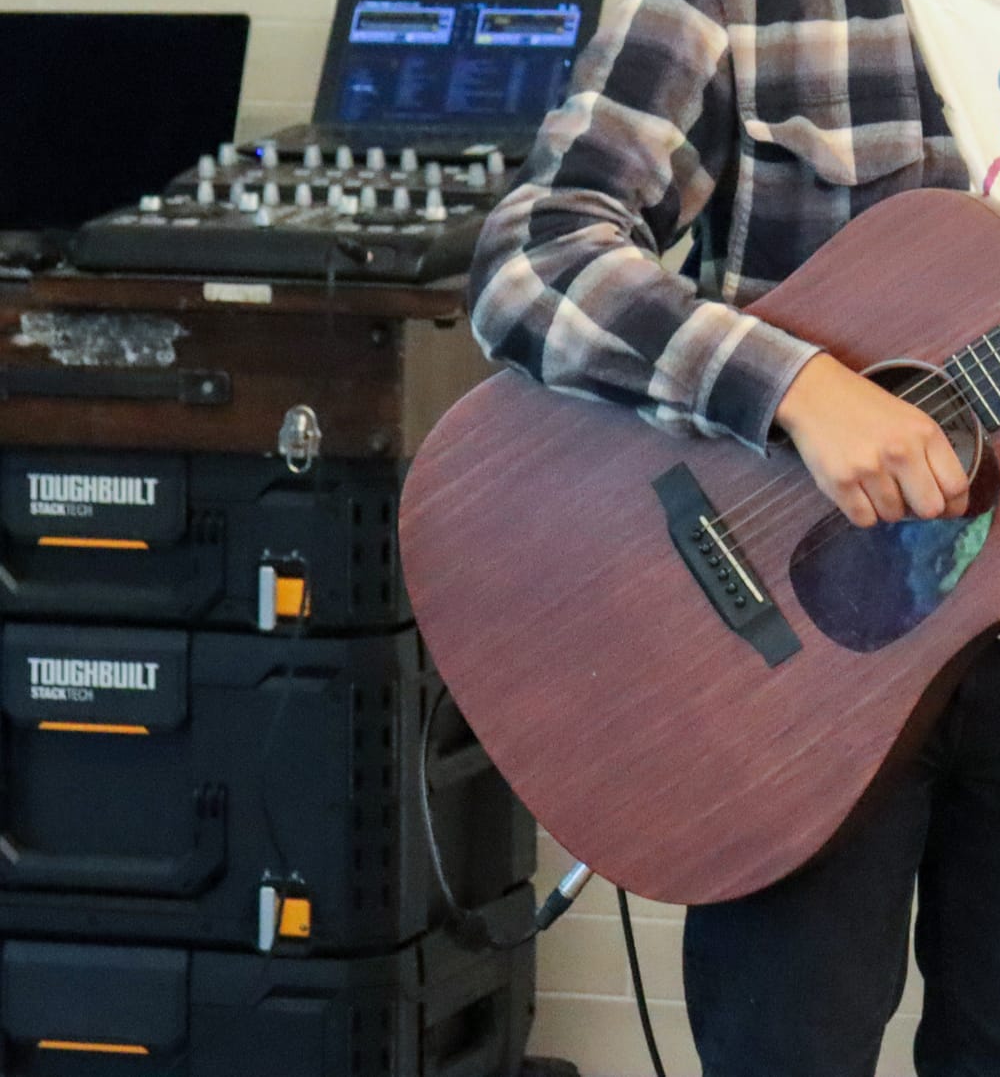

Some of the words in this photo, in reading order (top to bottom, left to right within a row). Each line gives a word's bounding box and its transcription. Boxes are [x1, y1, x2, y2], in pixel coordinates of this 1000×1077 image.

[27, 473, 160, 506] TOUGHBUILT
[27, 657, 160, 691] TOUGHBUILT
[30, 686, 94, 702] STACKTECH
